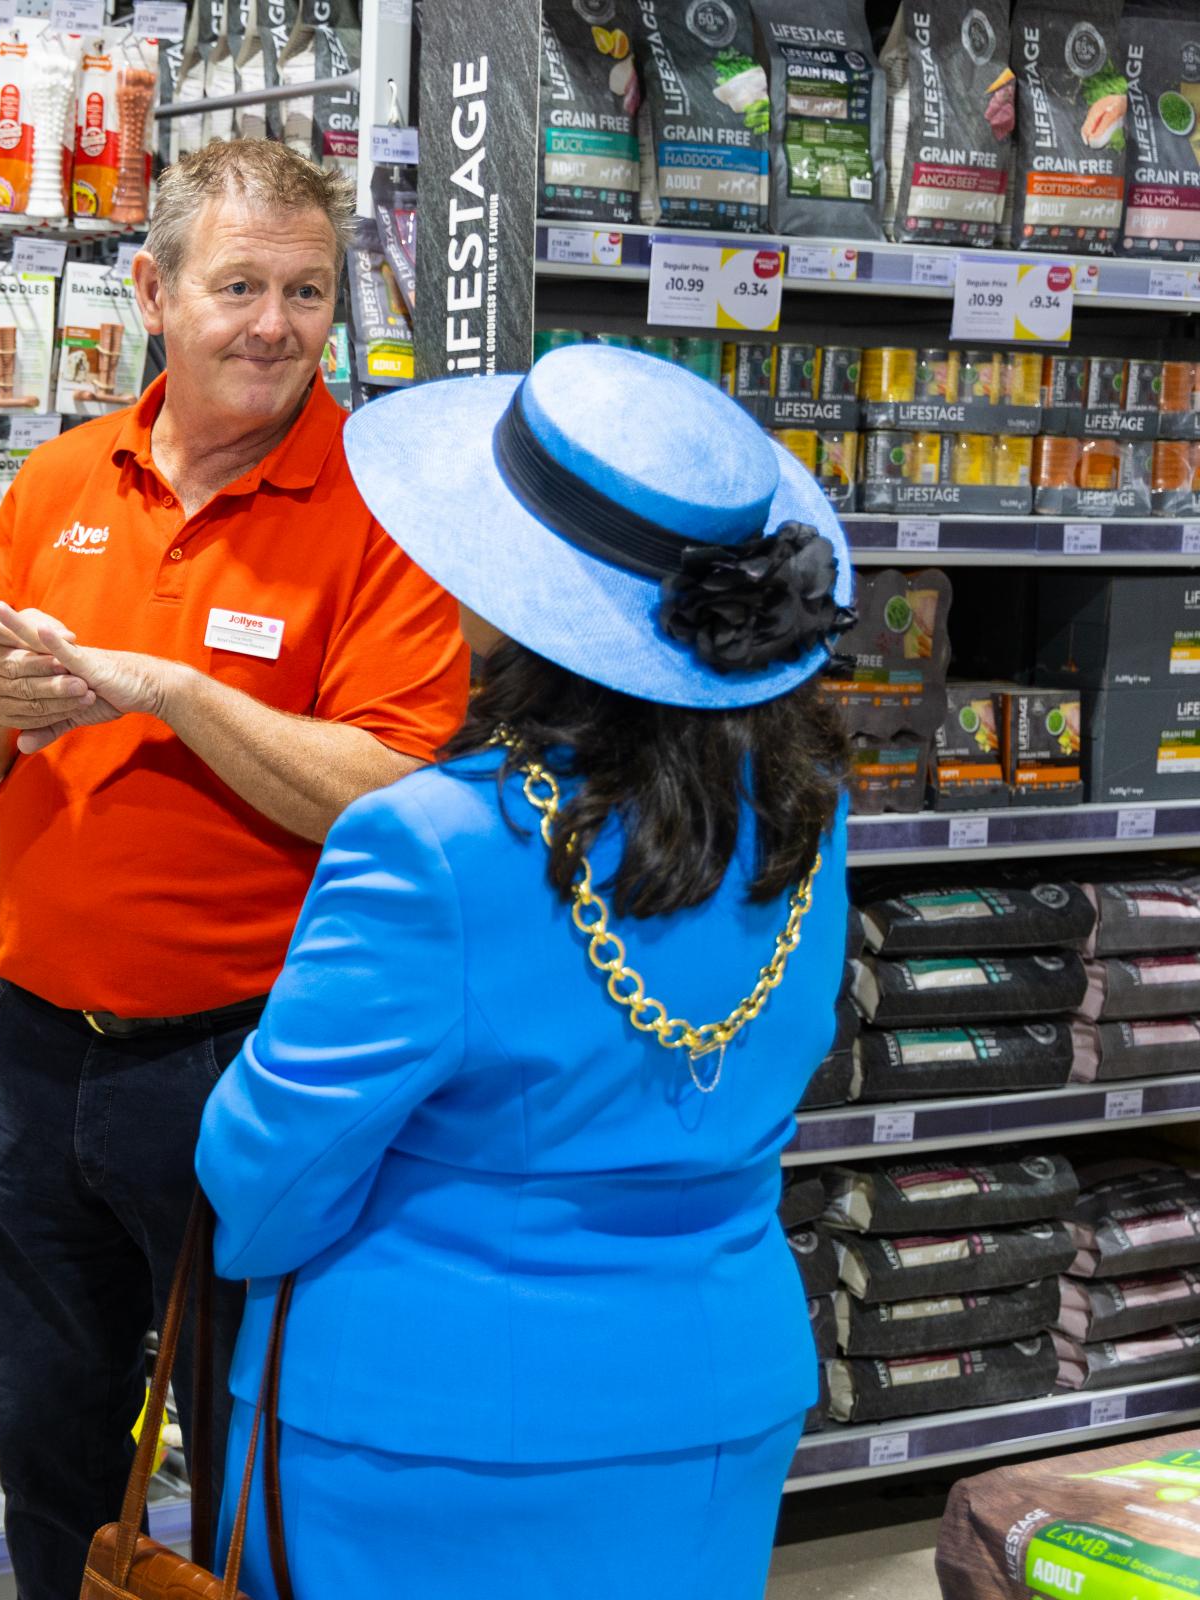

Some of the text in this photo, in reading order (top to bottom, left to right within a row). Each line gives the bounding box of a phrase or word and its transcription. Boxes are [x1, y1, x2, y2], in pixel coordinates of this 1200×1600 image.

[770, 22, 846, 46] LiFESTAGE
[787, 65, 820, 78] GRAIN
[913, 12, 940, 138] LiFESTAGE
[1024, 26, 1051, 147] LiFESTAGE
[1126, 45, 1155, 162] LiFESTAGE
[550, 110, 630, 132] GRAIN FREE
[663, 125, 751, 146] GRAIN FREE
[552, 137, 583, 151] DUCK
[664, 153, 725, 168] HADDOCK
[920, 146, 997, 168] GRAIN FREE
[1033, 156, 1113, 174] GRAIN FREE
[551, 161, 586, 177] ADULT
[1135, 167, 1200, 186] GRAIN FR
[665, 174, 702, 190] ADULT
[918, 174, 978, 188] ANGUS BEEF
[918, 195, 952, 210] ADULT
[1134, 194, 1179, 206] SALMON
[447, 55, 488, 377] iFESTAGE
[1031, 201, 1066, 217] ADULT
[1132, 215, 1168, 229] PUPPY
[663, 262, 709, 271] Regular Price
[487, 194, 499, 356] GOODNESS FULL OF FLAVOUR
[359, 252, 379, 326] LiFESTAGE
[665, 277, 704, 292] £10.99
[734, 282, 768, 296] £9.34
[966, 279, 1007, 288] Regular Price
[968, 294, 1003, 307] £10.99
[1030, 297, 1060, 309] £9.34
[369, 327, 404, 339] GRAIN
[373, 359, 402, 371] ADULT
[774, 402, 841, 419] LiFESTAGE
[899, 405, 965, 422] LiFESTAGE
[1084, 413, 1145, 431] LiFESTAGE
[897, 488, 960, 502] LiFESTAGE
[1077, 491, 1135, 506] LiFESTAGE
[53, 521, 110, 549] Jollyes
[228, 614, 263, 629] Jollyes
[856, 655, 883, 668] FREE
[1019, 697, 1029, 751] LIFESTAGE
[1004, 1508, 1050, 1581] LiFESTAGE
[1046, 1527, 1199, 1590] LAMB and brown rice
[1032, 1557, 1085, 1595] ADULT
